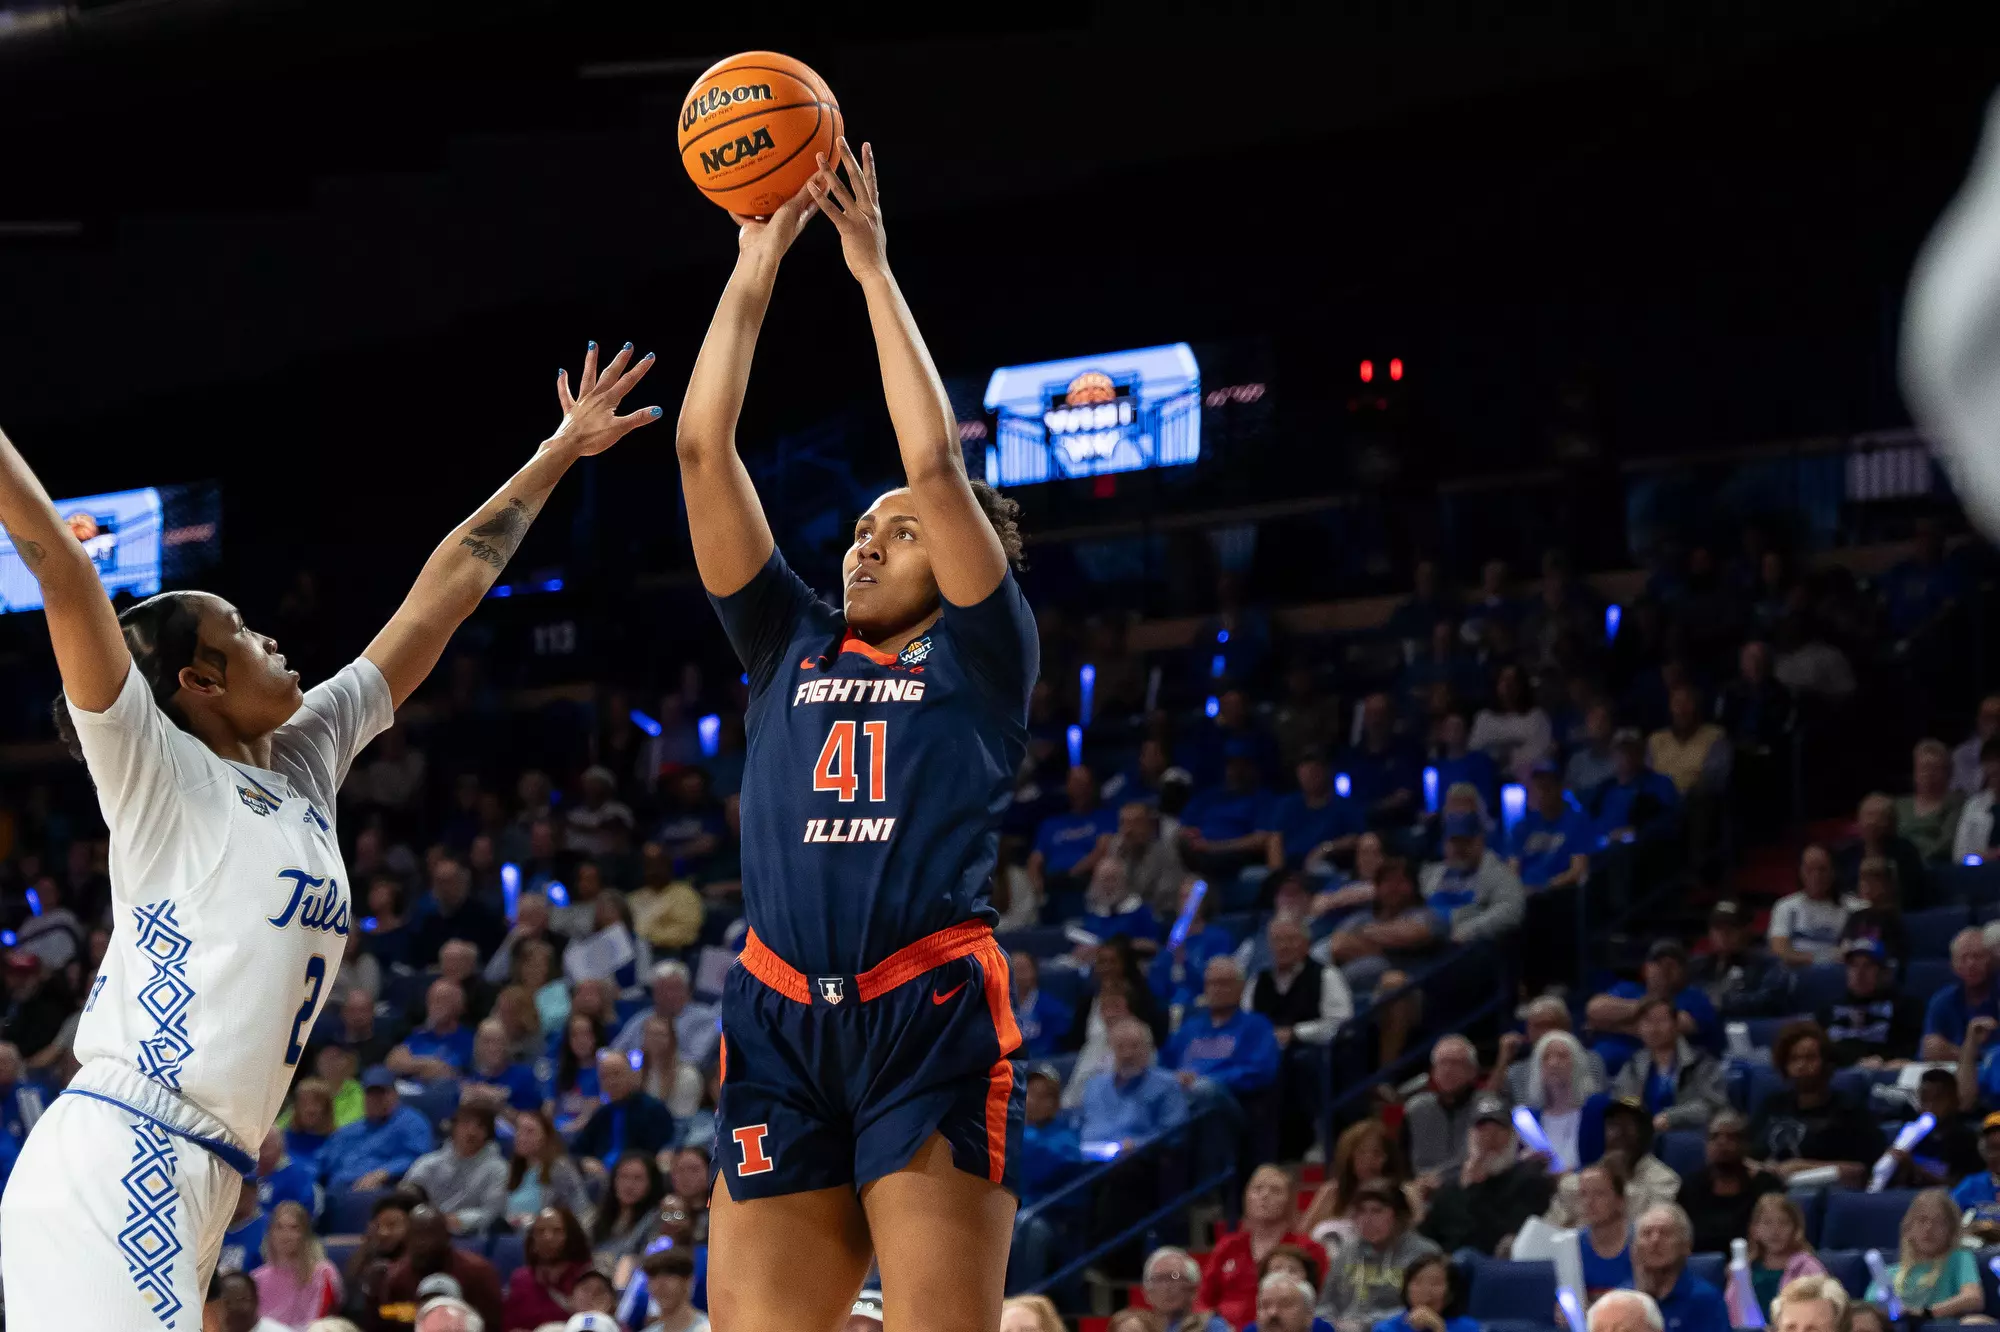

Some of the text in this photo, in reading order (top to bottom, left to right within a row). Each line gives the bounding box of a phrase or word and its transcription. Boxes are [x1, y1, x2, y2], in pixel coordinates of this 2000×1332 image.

[682, 83, 773, 132] Wilson
[700, 127, 775, 174] NCAA
[901, 642, 932, 662] WBIT
[793, 679, 926, 706] FIGHTING
[813, 720, 887, 802] 41
[803, 818, 896, 843] ILLINI
[265, 866, 349, 937] Tuls
[284, 953, 326, 1068] 2
[732, 1123, 774, 1177] I
